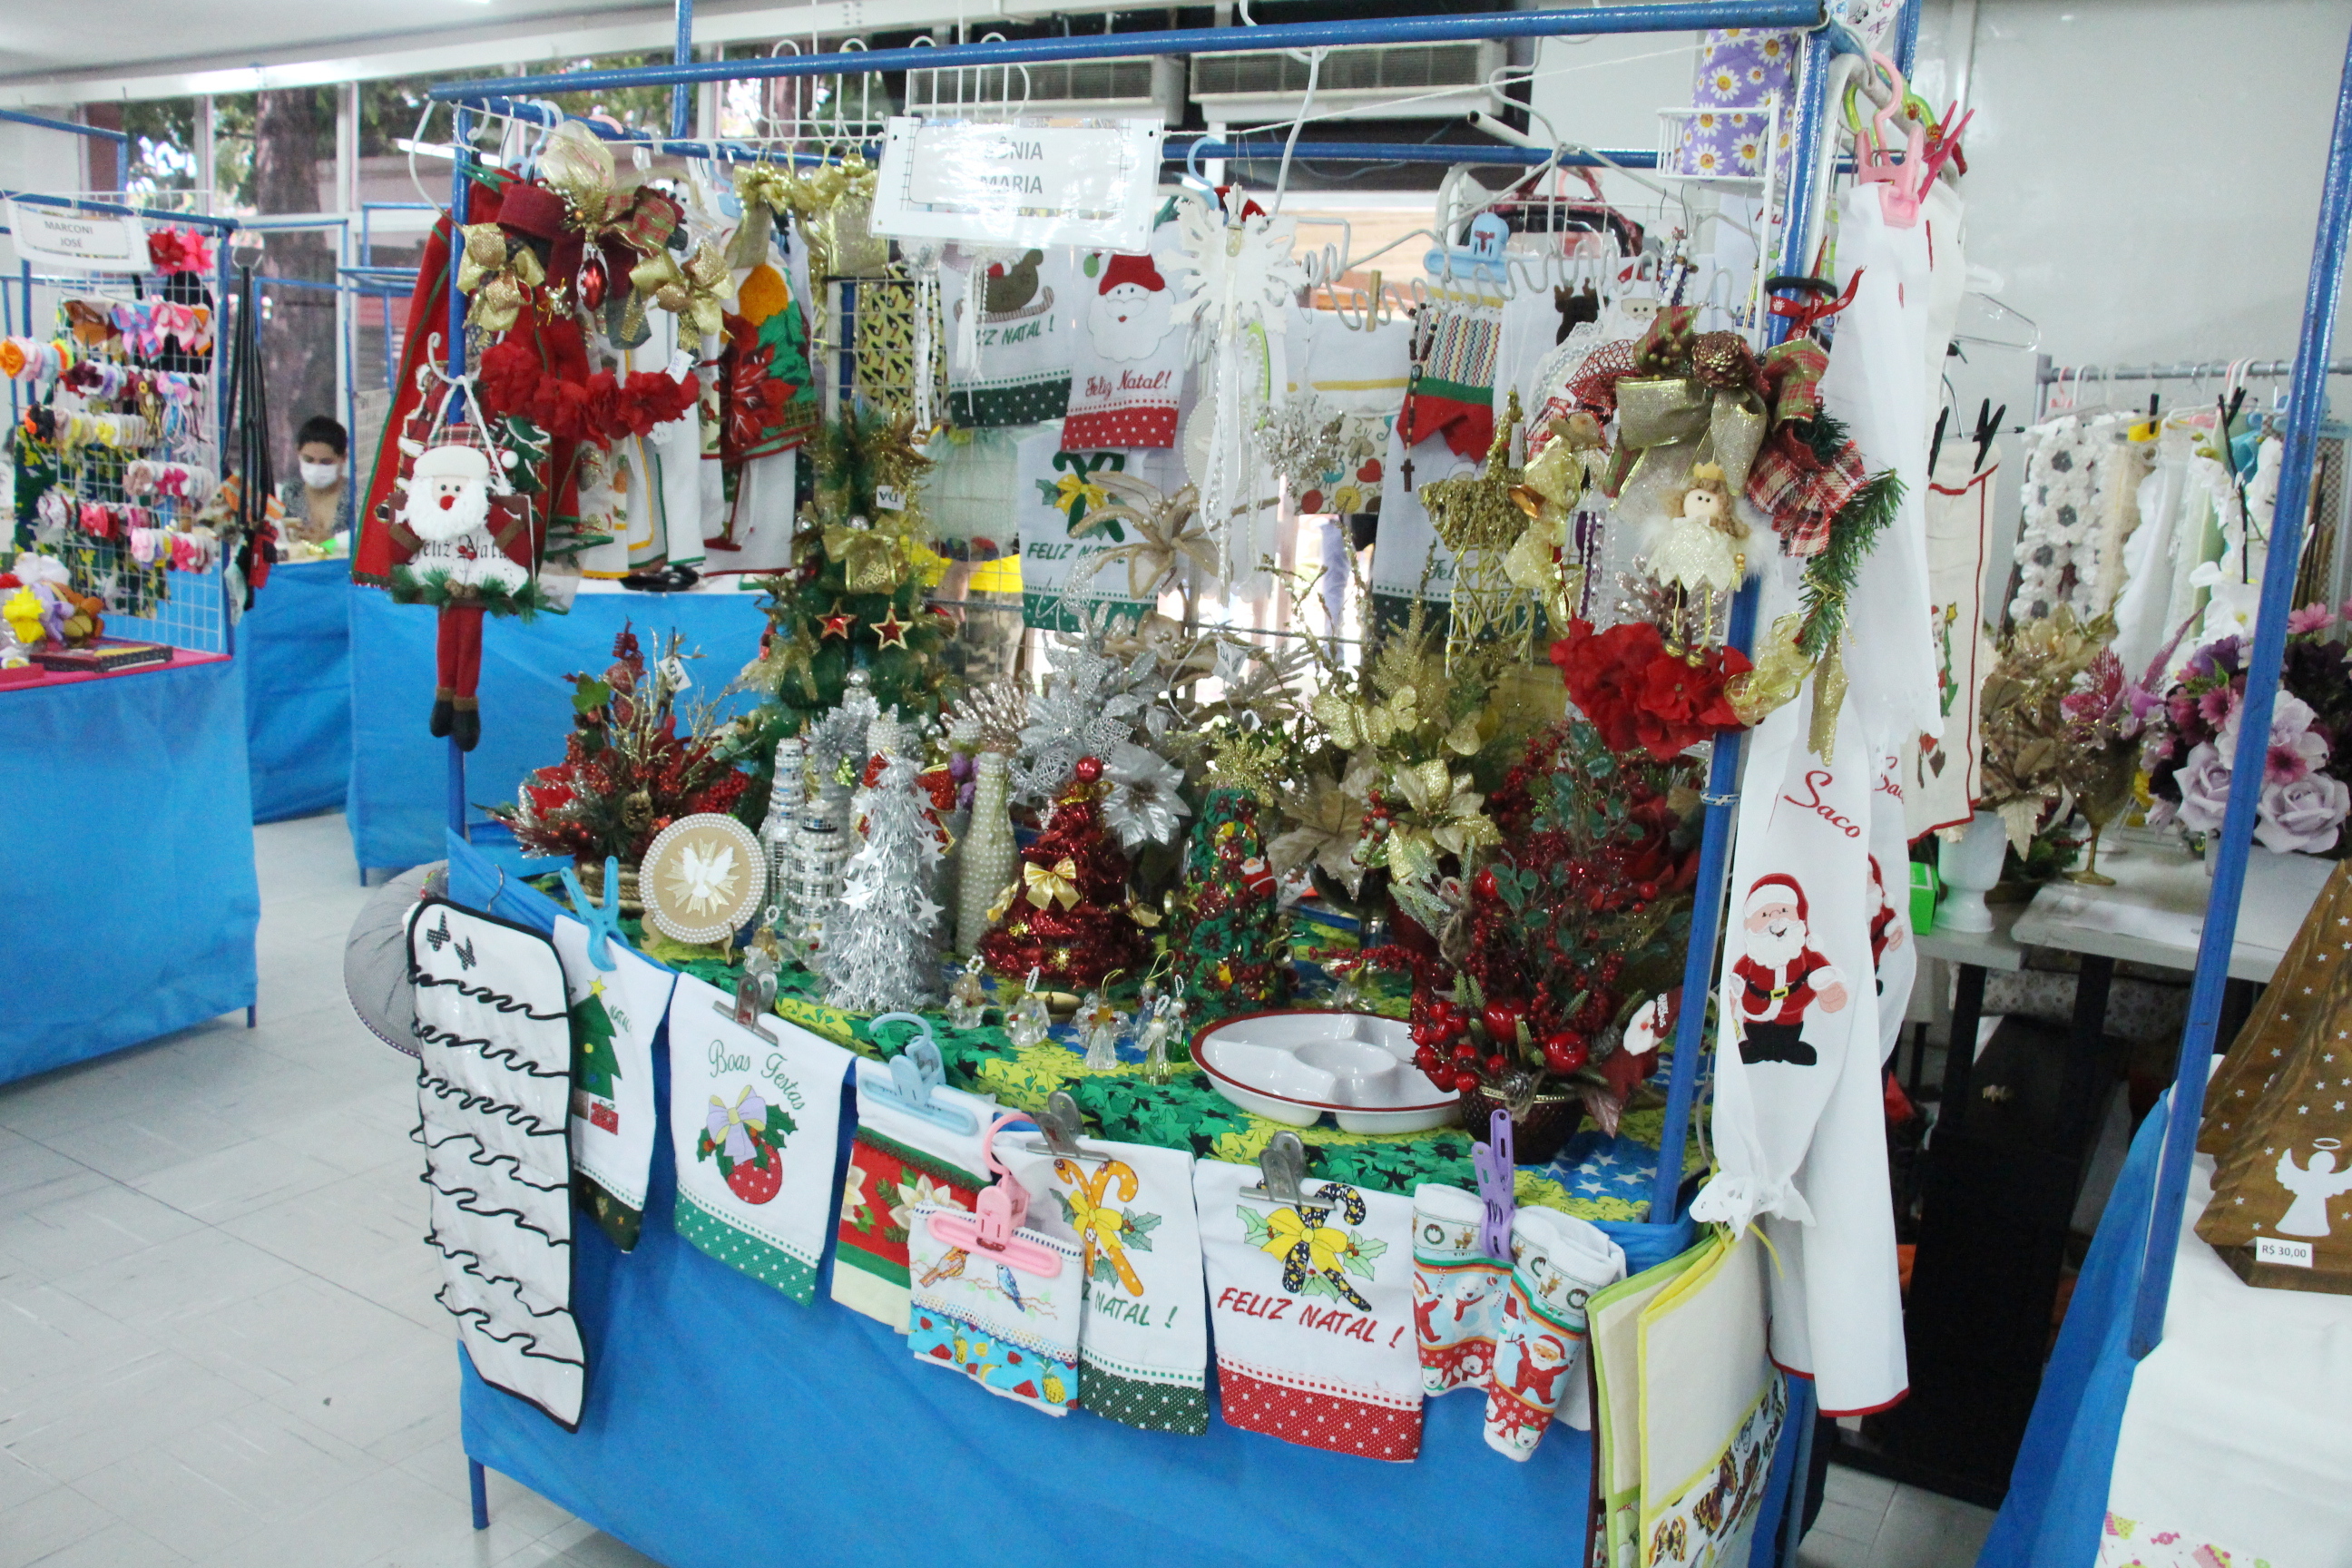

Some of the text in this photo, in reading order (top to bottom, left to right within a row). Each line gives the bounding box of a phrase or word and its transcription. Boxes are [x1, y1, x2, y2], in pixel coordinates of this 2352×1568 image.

[985, 135, 1043, 160] ÔNIA
[981, 175, 1043, 194] MARIA
[44, 220, 93, 235] MARCONI
[60, 236, 83, 249] JOSÉ
[1001, 320, 1041, 345] NATAL
[1085, 369, 1171, 400] Feliz Natal!
[1026, 543, 1073, 560] FELIZ
[1783, 769, 1860, 838] Saco
[708, 1039, 806, 1110] Boas Festas
[2262, 1244, 2307, 1258] R$ 30,00
[1094, 1289, 1150, 1326] NATAL
[1217, 1287, 1292, 1320] FELIZ
[1298, 1304, 1378, 1343] NATAL
